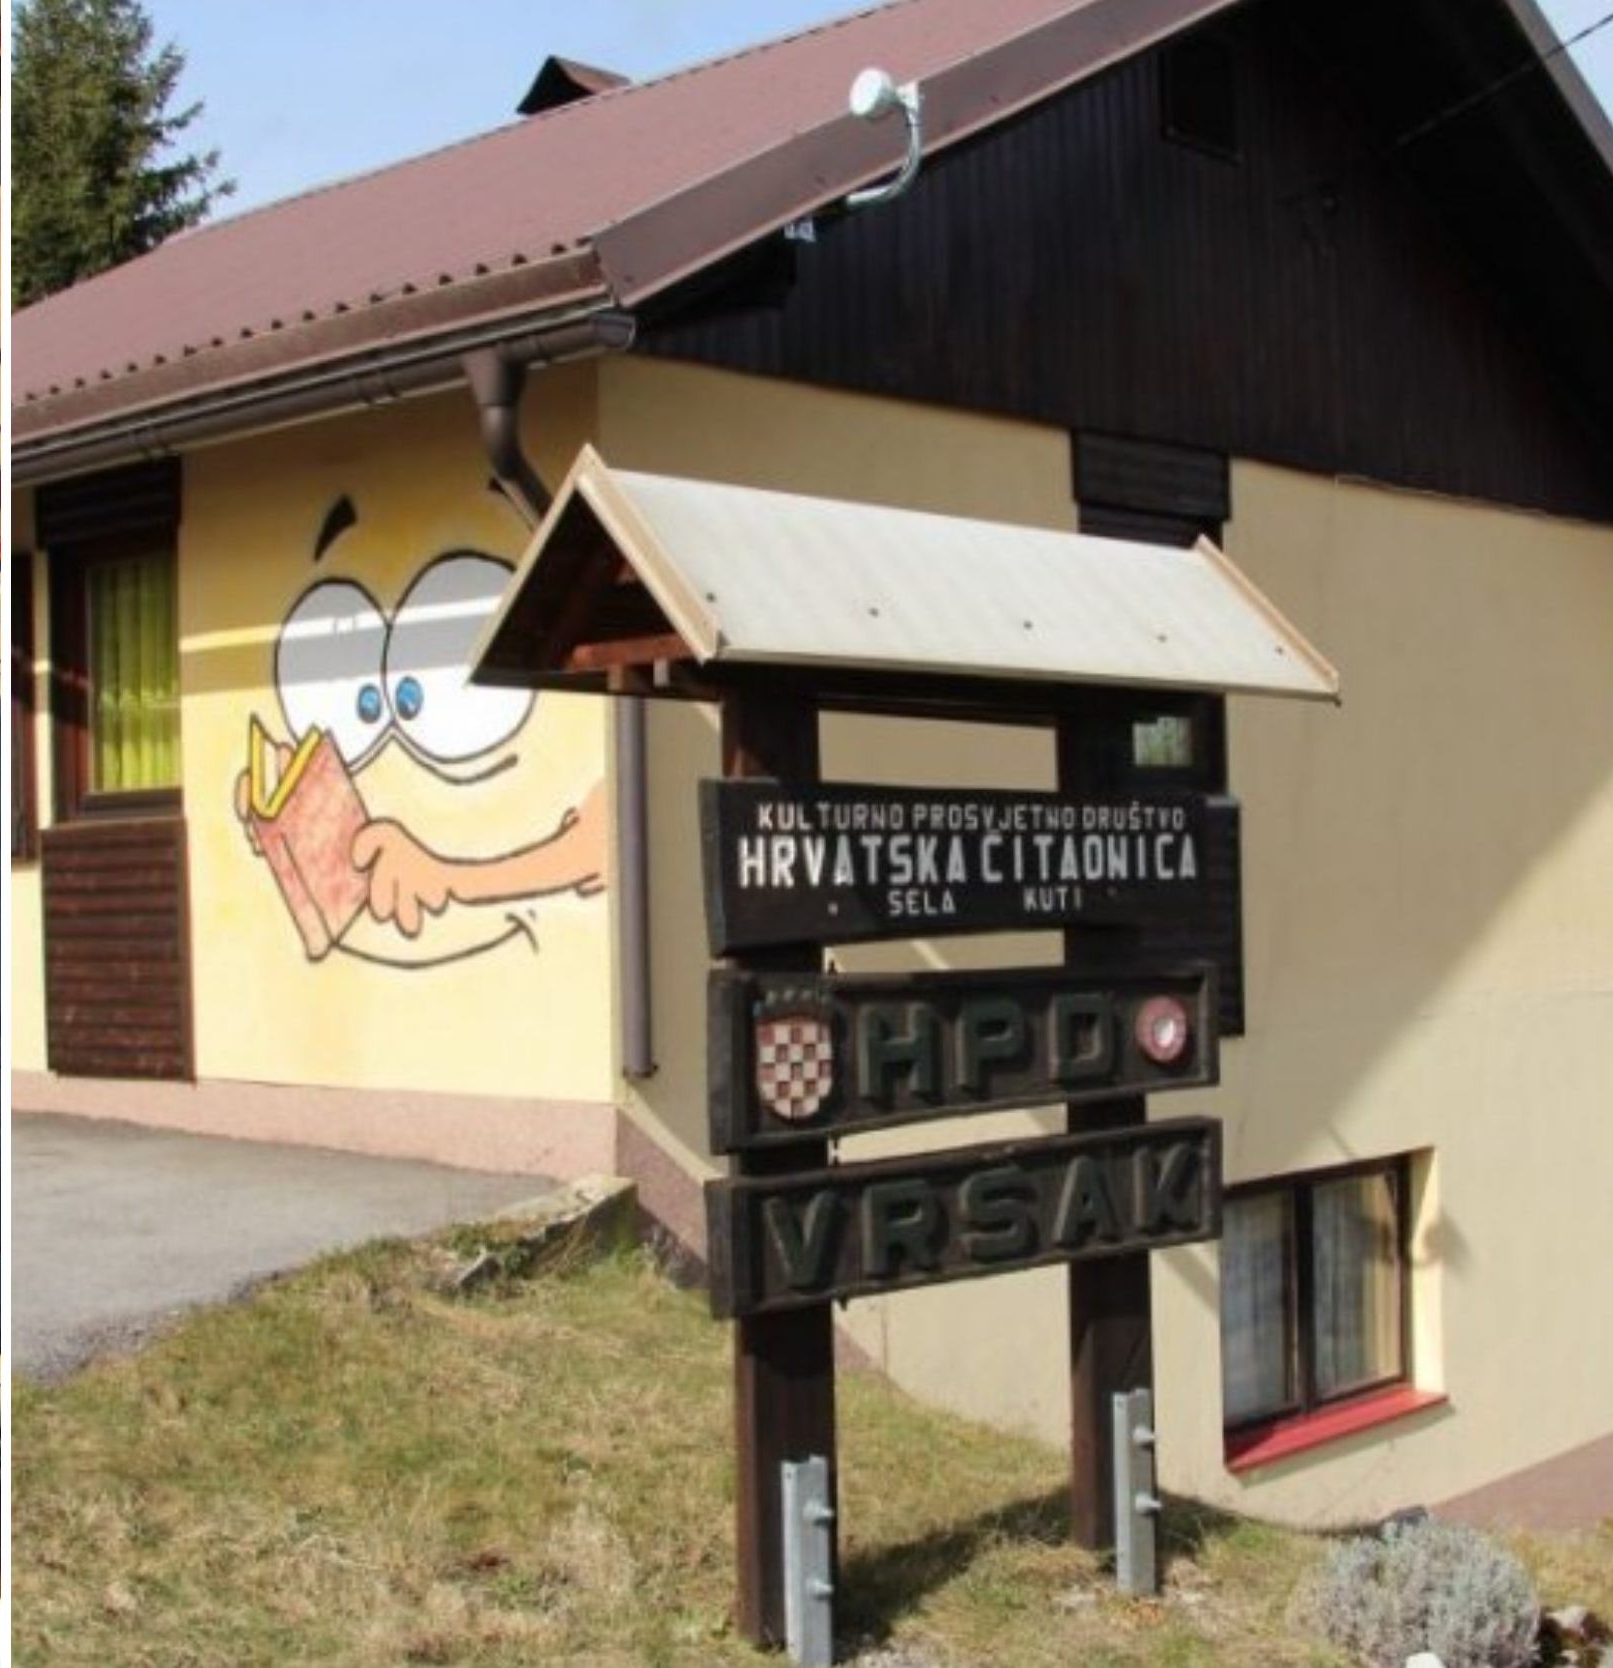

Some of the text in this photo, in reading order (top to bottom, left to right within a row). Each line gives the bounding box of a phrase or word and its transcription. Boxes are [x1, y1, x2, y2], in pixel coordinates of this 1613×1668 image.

[758, 801, 1185, 831] KULTURNO PROSVJETNO DRUŠTVO
[738, 828, 1197, 888] HRVATSKA ČITAONICA
[887, 886, 1083, 916] SELA KUTI
[858, 992, 1117, 1097] HPD
